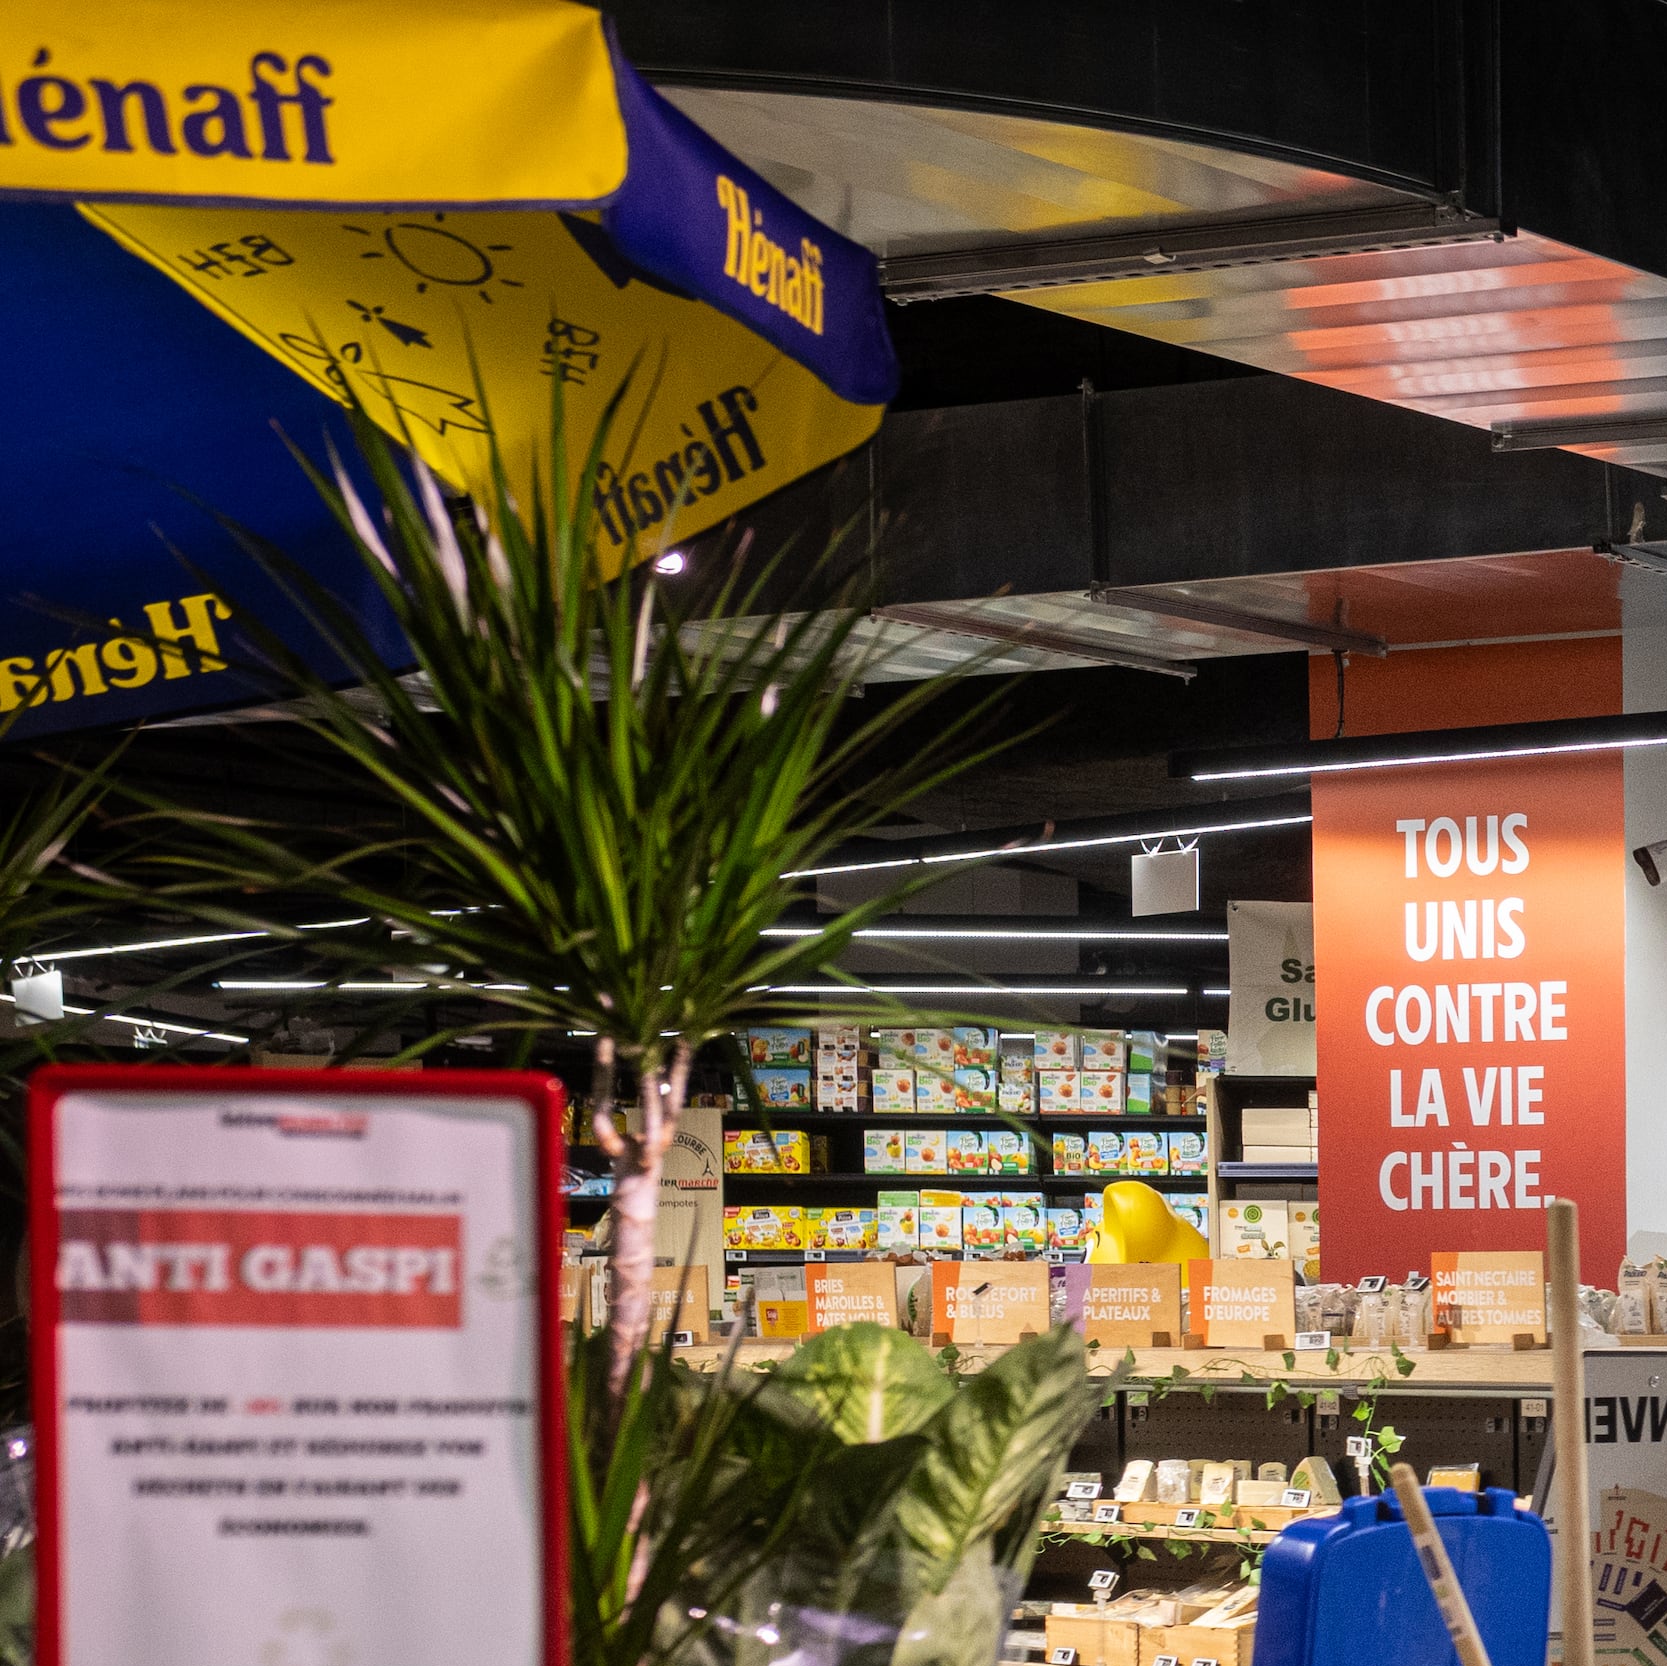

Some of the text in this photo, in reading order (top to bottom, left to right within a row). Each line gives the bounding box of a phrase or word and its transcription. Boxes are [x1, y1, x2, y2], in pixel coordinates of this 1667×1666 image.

[0, 48, 336, 165] énaff
[717, 175, 824, 336] Hénaff
[1396, 813, 1530, 879] TOUS
[1404, 897, 1526, 962] UNIS
[1365, 981, 1568, 1047] CONTRE
[1390, 1065, 1545, 1127] LA VIE
[673, 1133, 706, 1155] COURBE
[1378, 1141, 1556, 1212] CHÈRE.
[57, 1242, 457, 1294] ANTI GASPI
[814, 1279, 843, 1294] BRIES
[1436, 1270, 1536, 1287] SAINT NECTAIRE
[815, 1296, 884, 1310] MAROILLES &
[1082, 1287, 1161, 1303] APERITIFS &
[1203, 1286, 1276, 1303] FROMAGES
[1437, 1290, 1507, 1306] MORBIER &
[946, 1305, 956, 1319] &
[1083, 1306, 1151, 1321] PLATEAUX
[1204, 1305, 1270, 1322] D'EUROPE
[1438, 1309, 1541, 1326] AUTRES TOMMES
